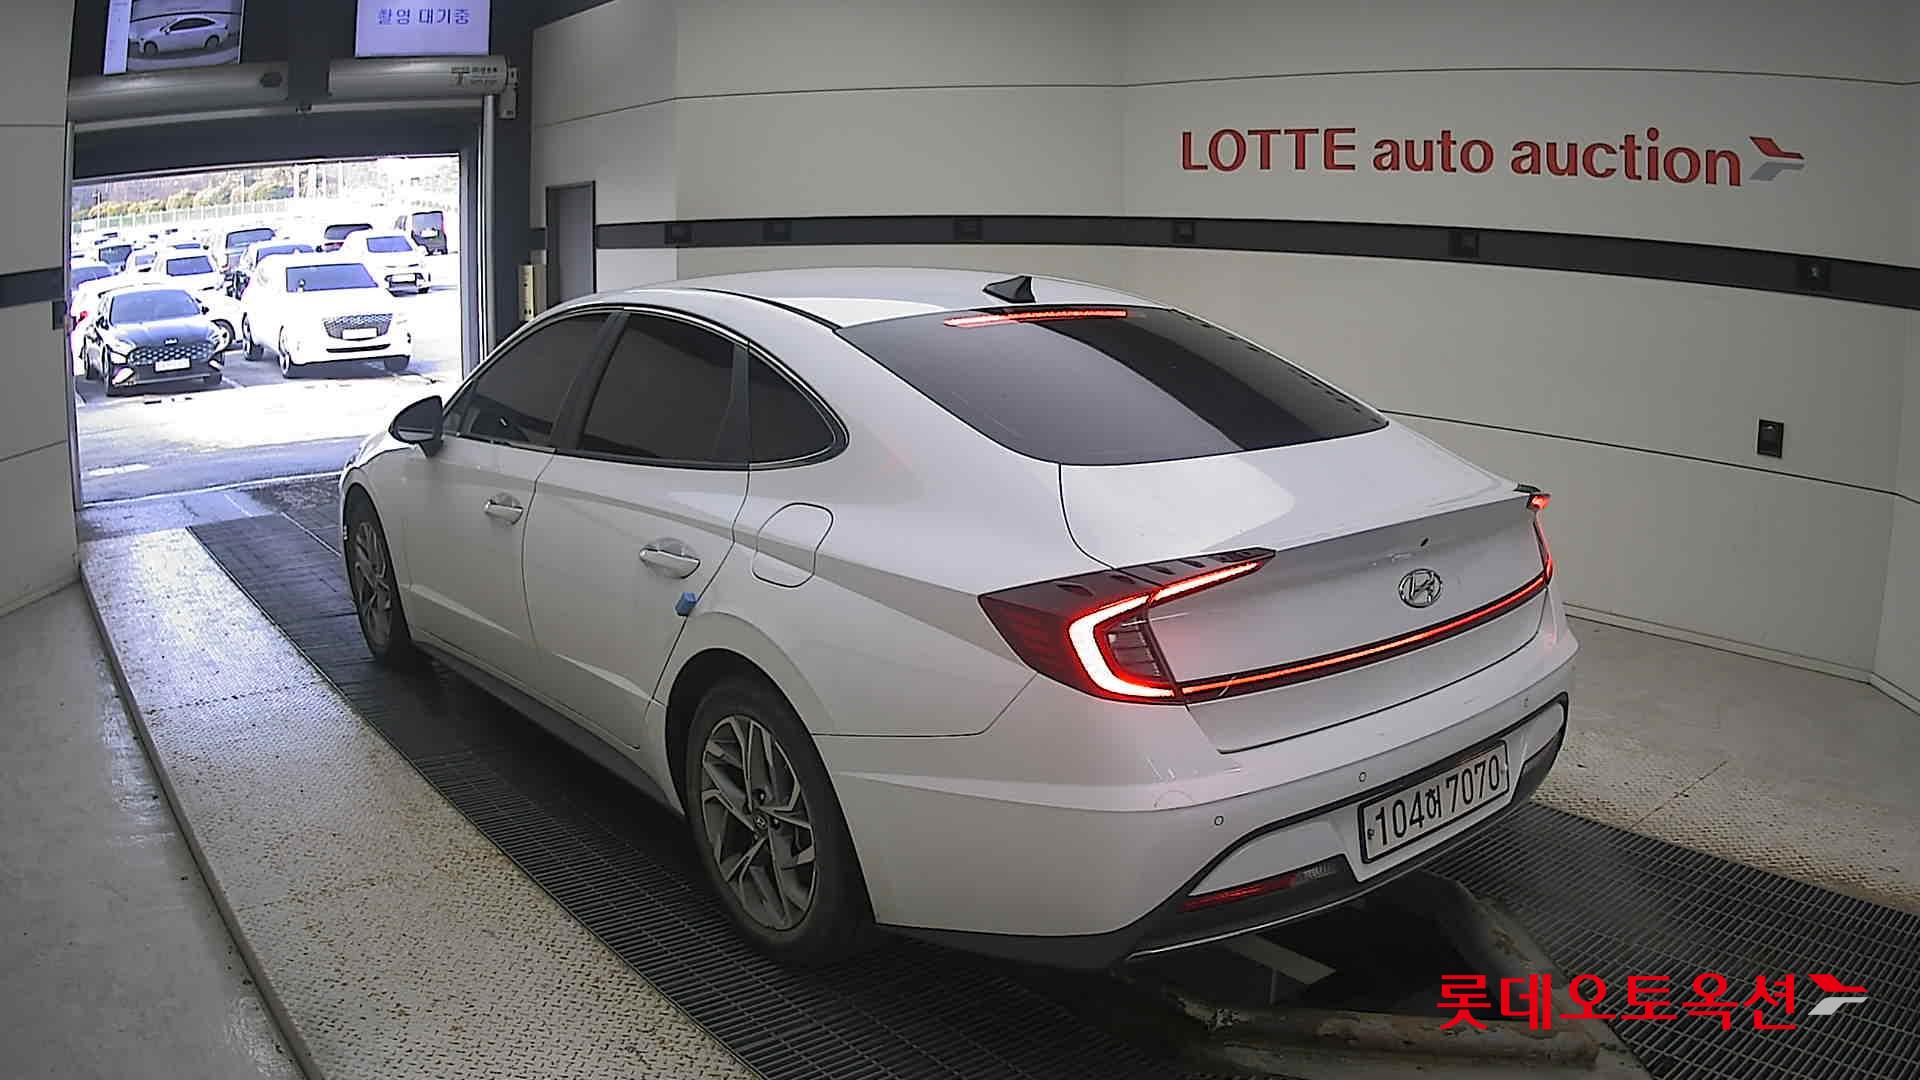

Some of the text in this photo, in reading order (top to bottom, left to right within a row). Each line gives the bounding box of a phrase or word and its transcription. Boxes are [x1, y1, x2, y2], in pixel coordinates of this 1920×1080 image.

[419, 8, 470, 25] 대기중
[1181, 127, 1742, 187] LOTTE auto auction
[1375, 755, 1500, 846] 104허 7070
